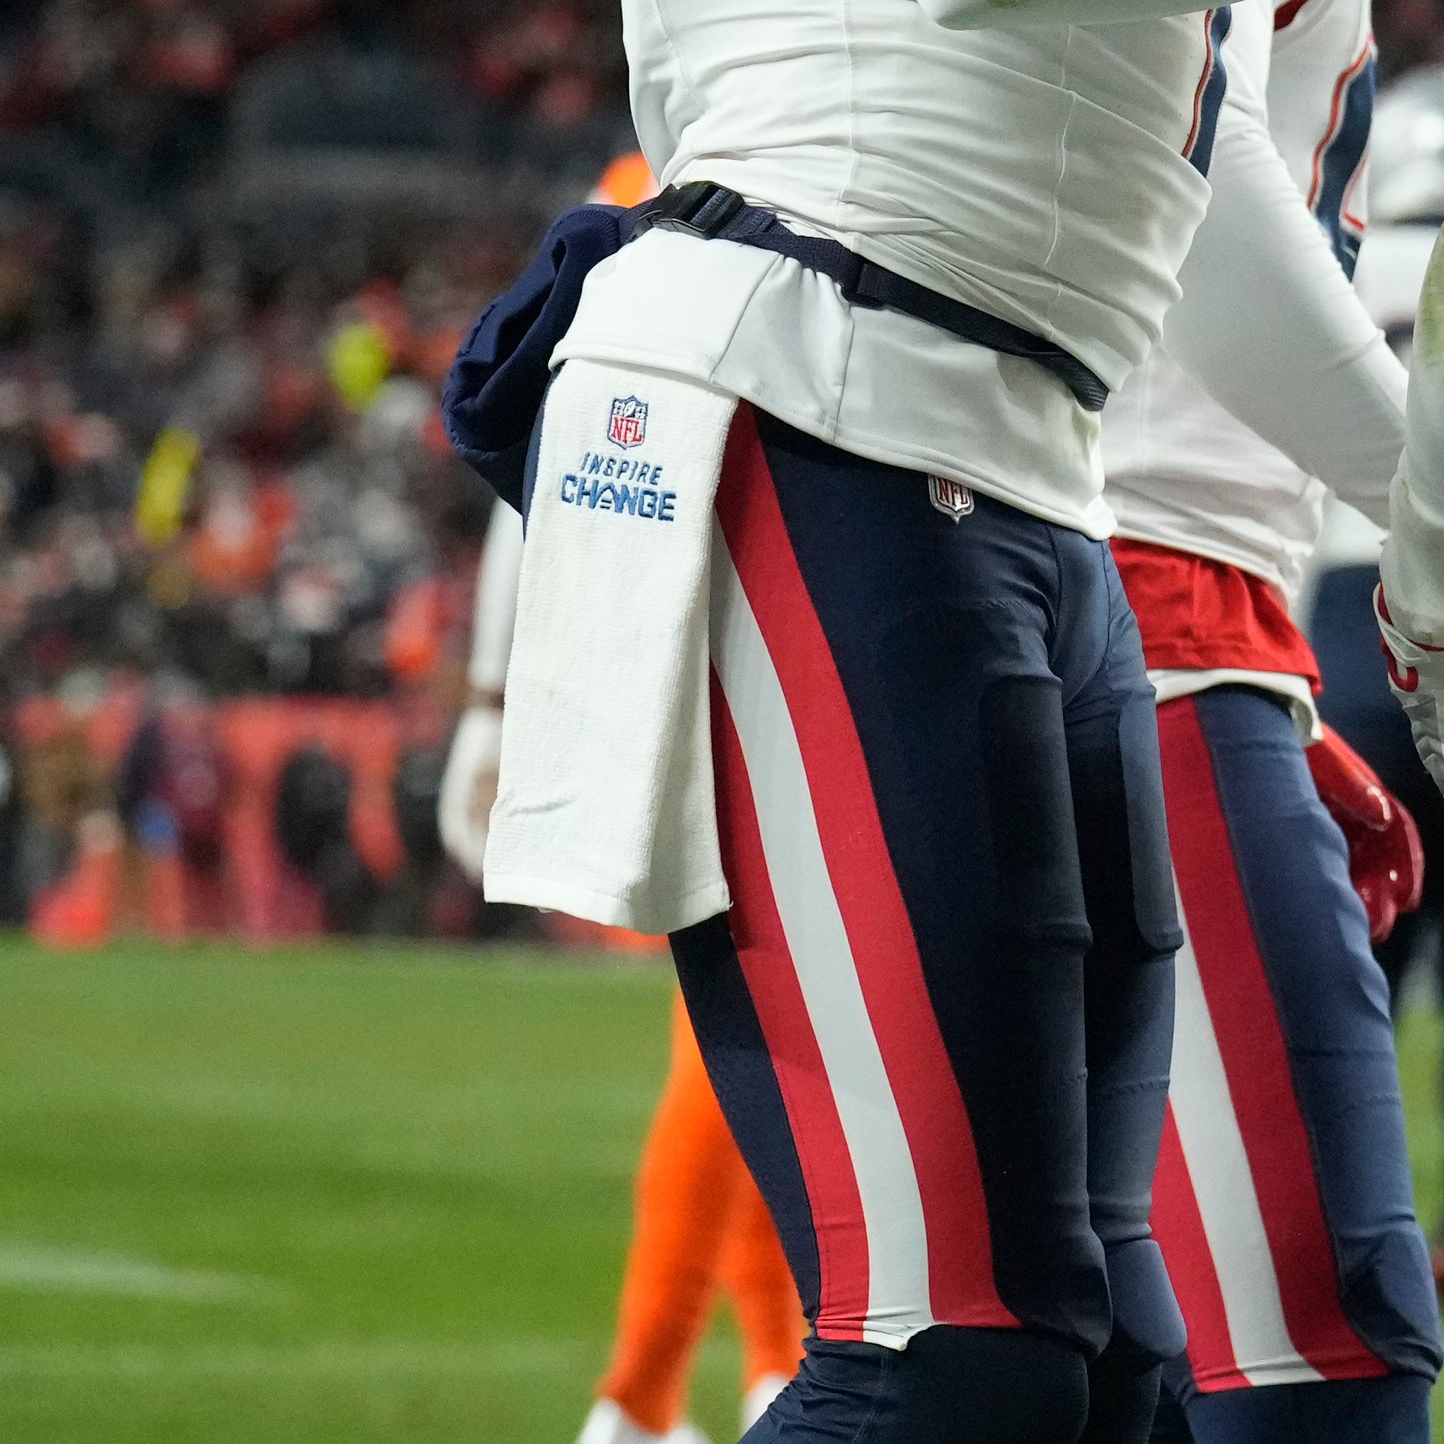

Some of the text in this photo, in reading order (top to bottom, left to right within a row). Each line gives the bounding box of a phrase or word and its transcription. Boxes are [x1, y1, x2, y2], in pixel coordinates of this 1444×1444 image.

[611, 416, 643, 444] NFL
[580, 451, 663, 486] INSPIRE
[561, 473, 677, 523] CHANGE
